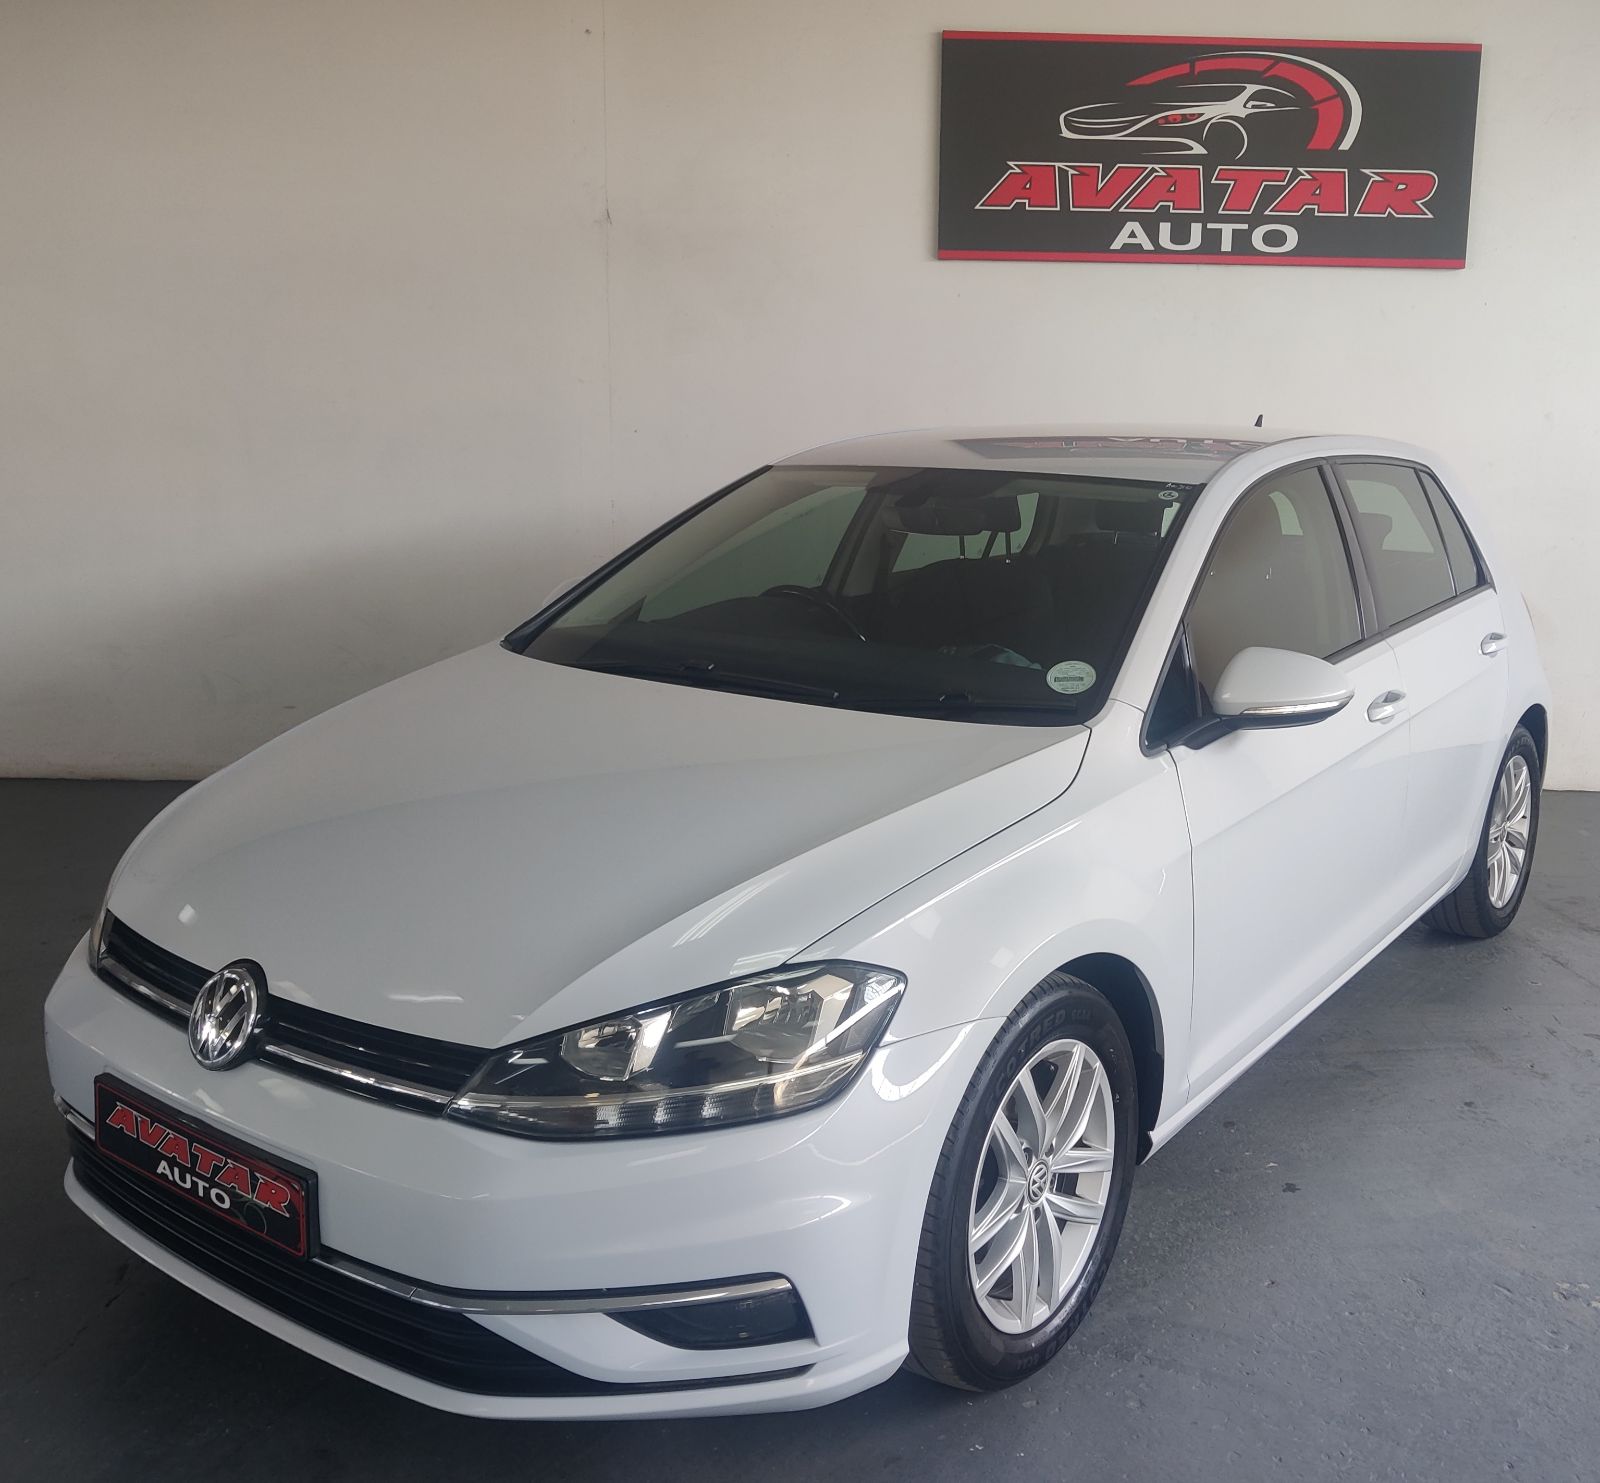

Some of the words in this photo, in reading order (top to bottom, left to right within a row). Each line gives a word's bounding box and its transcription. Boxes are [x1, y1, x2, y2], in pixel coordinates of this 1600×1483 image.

[974, 161, 1438, 218] AVATAR
[1109, 221, 1299, 254] AUTO
[106, 1101, 291, 1217] AVATAR
[156, 1159, 231, 1210] AUTO
